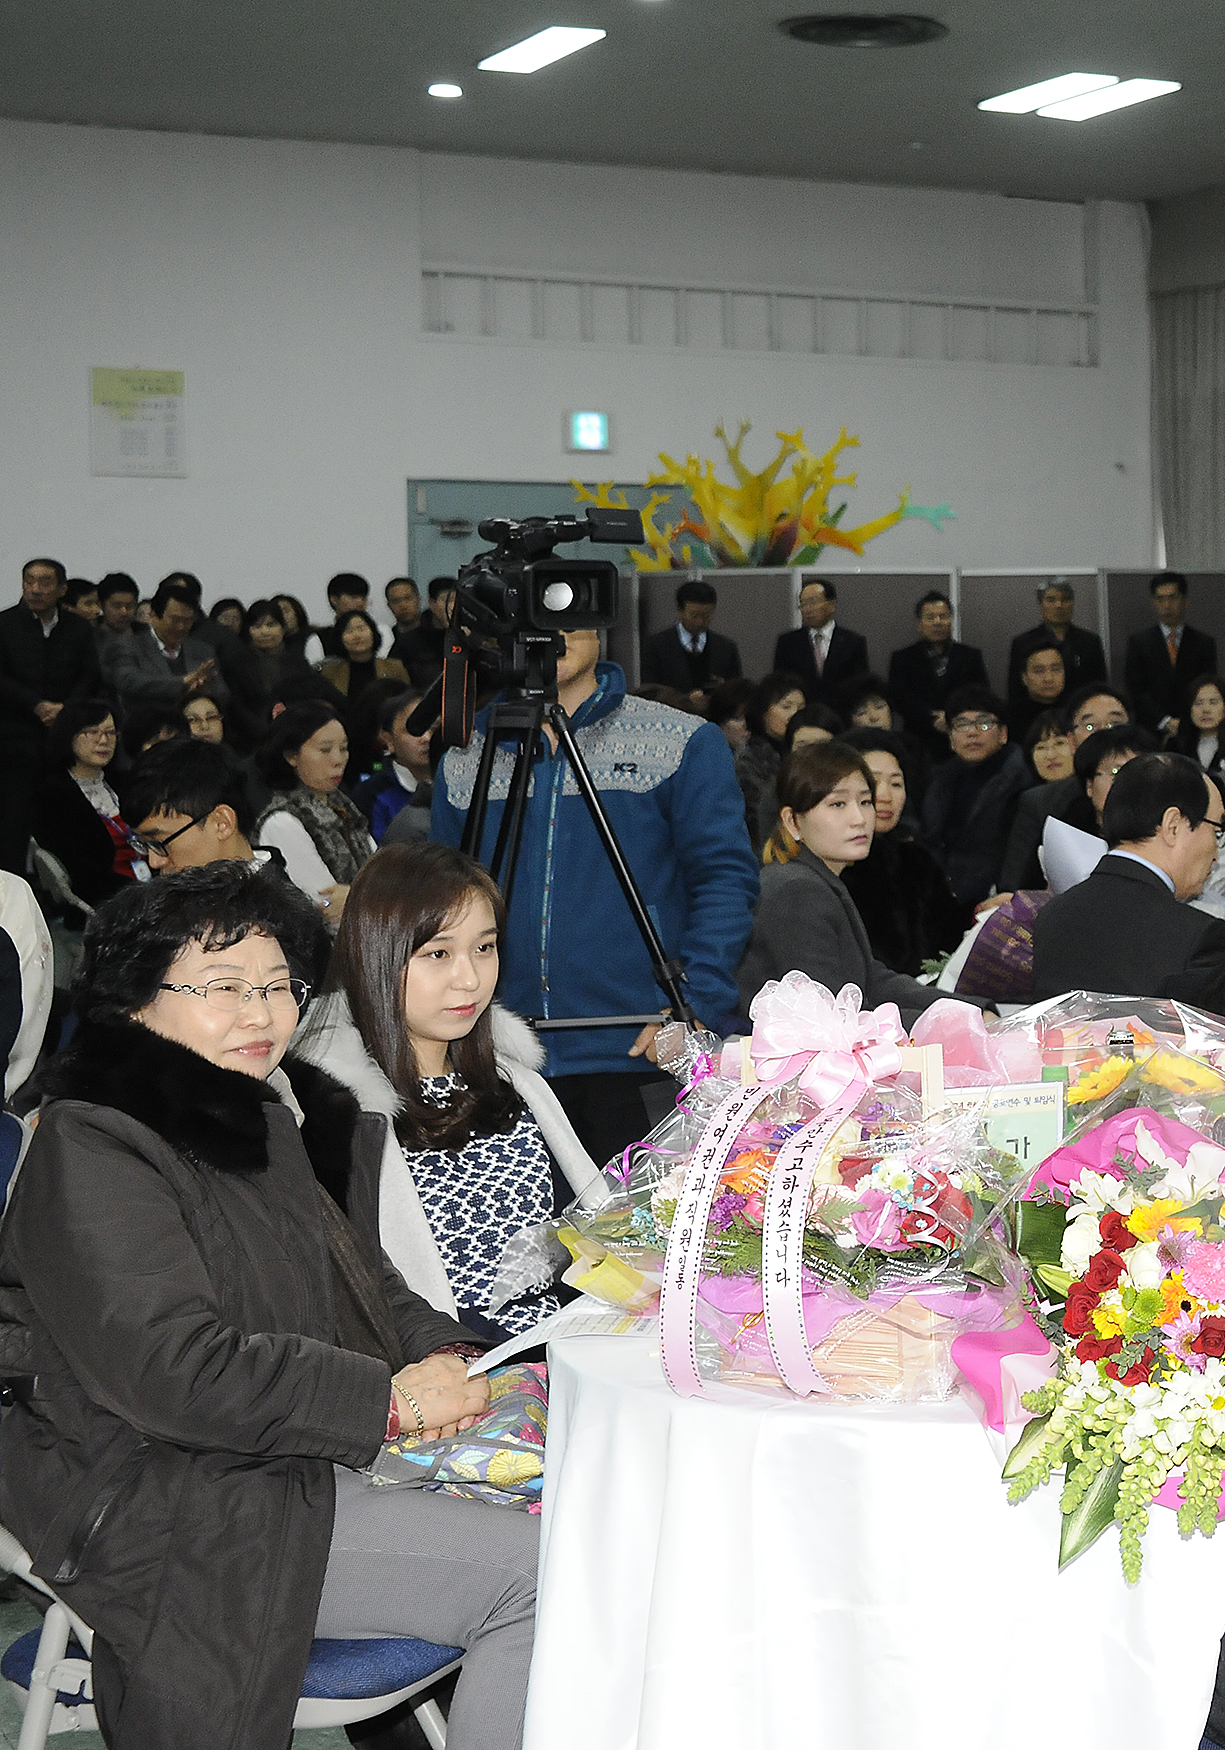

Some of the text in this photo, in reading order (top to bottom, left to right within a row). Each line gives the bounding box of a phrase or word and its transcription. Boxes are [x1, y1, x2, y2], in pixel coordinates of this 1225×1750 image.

[613, 762, 638, 774] K2
[1023, 1096, 1032, 1106] 및
[1034, 1094, 1056, 1105] 퇴임식
